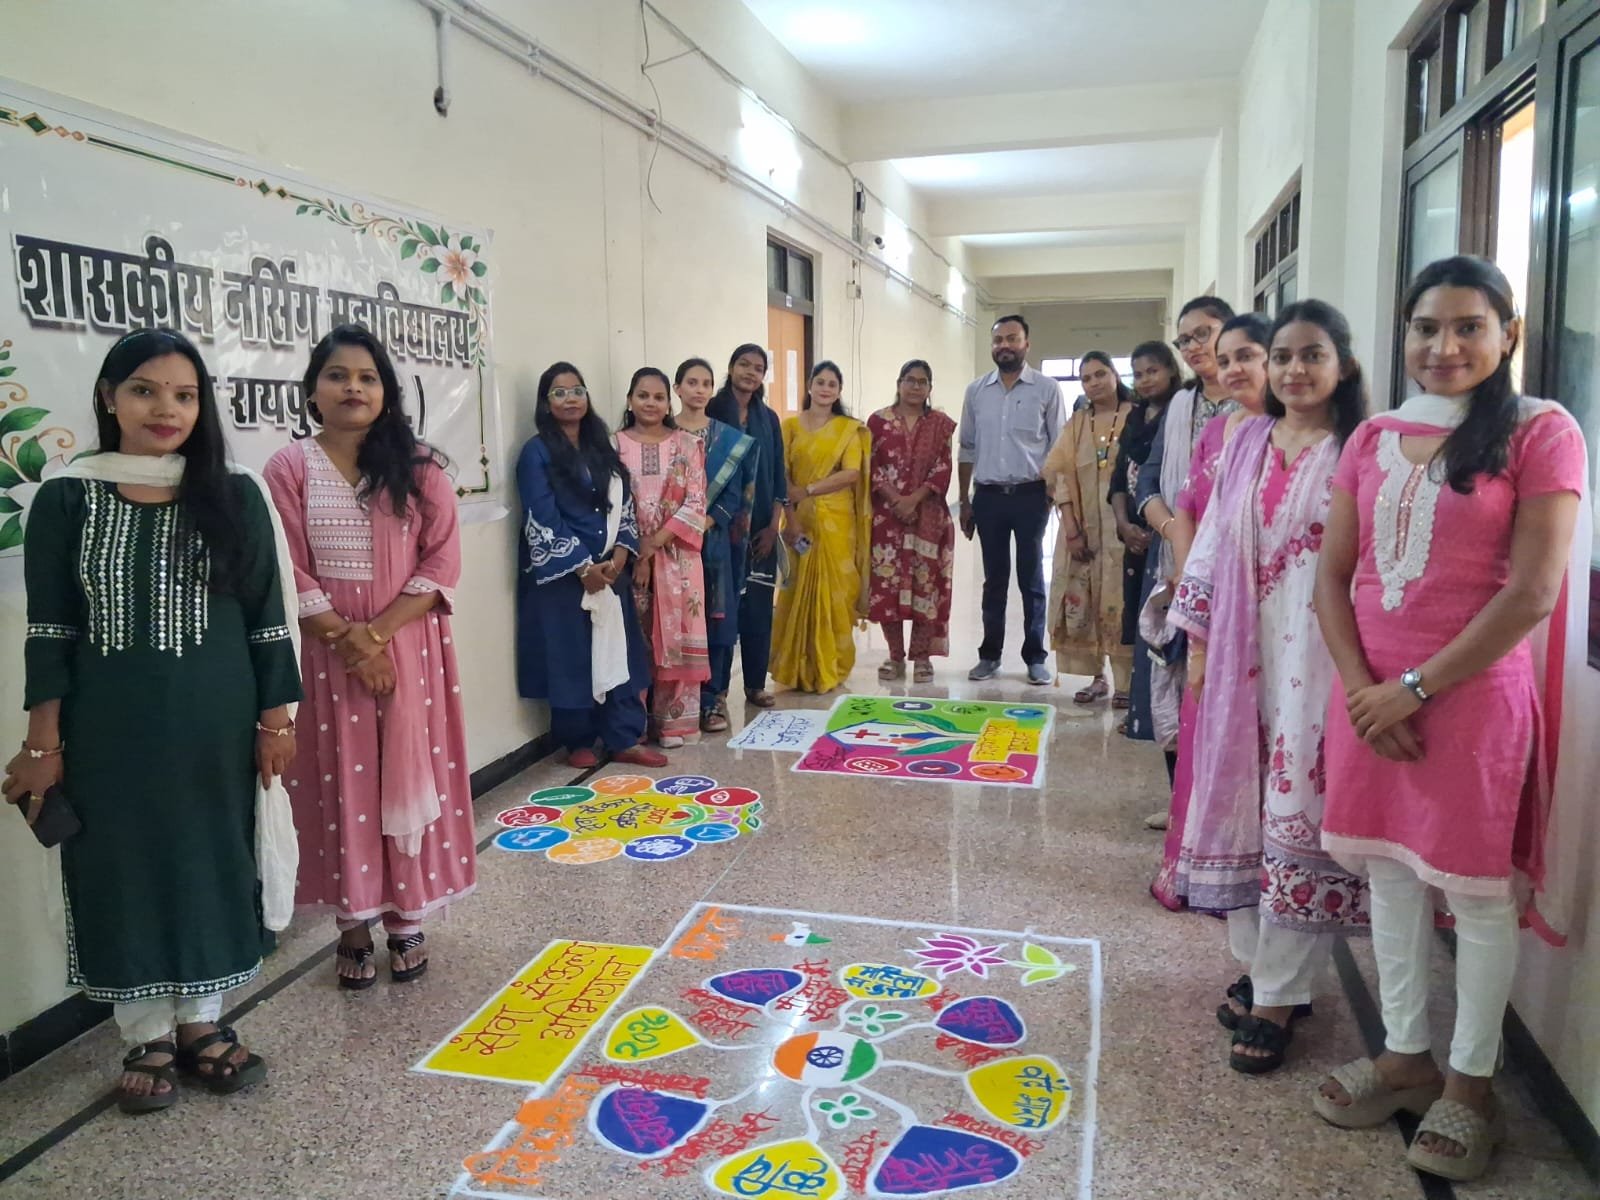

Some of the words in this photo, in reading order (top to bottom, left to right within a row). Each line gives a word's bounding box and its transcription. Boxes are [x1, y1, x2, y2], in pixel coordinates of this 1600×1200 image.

[15, 233, 214, 336] शासकीय
[227, 376, 323, 441] रायपु
[450, 1003, 543, 1056] सेवा
[510, 941, 614, 1001] संकल्प
[540, 955, 642, 1040] अभियान
